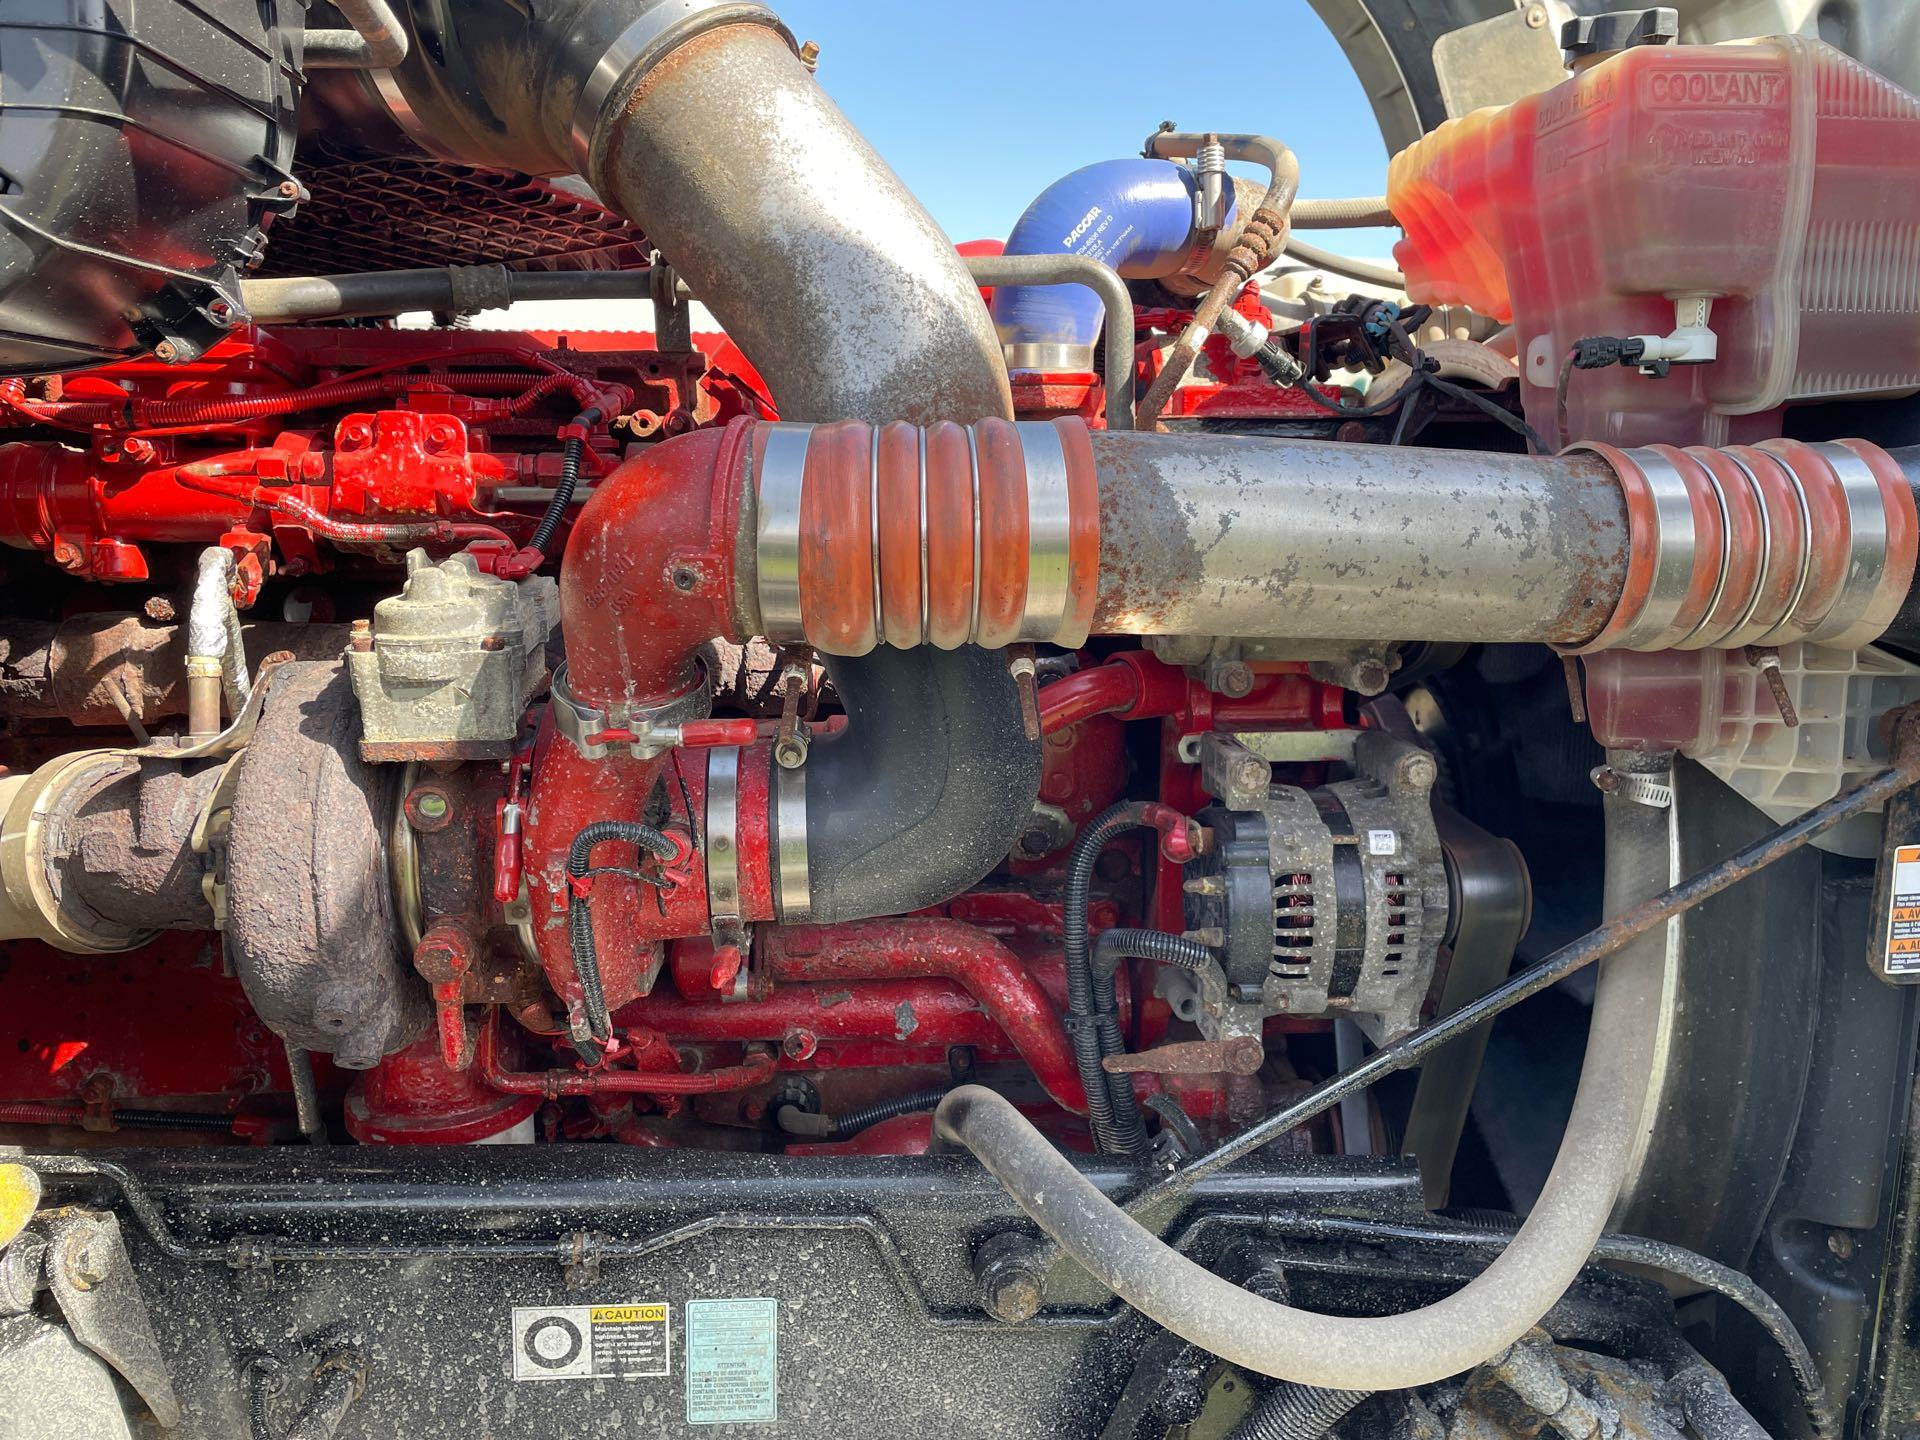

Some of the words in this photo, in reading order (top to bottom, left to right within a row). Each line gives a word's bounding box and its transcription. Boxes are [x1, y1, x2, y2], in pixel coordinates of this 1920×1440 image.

[1651, 73, 1781, 104] COOLANT
[1062, 206, 1102, 249] PACCAR
[1096, 219, 1110, 234] REV
[1111, 224, 1135, 250] VIETNAM
[605, 1309, 664, 1320] CAUTION
